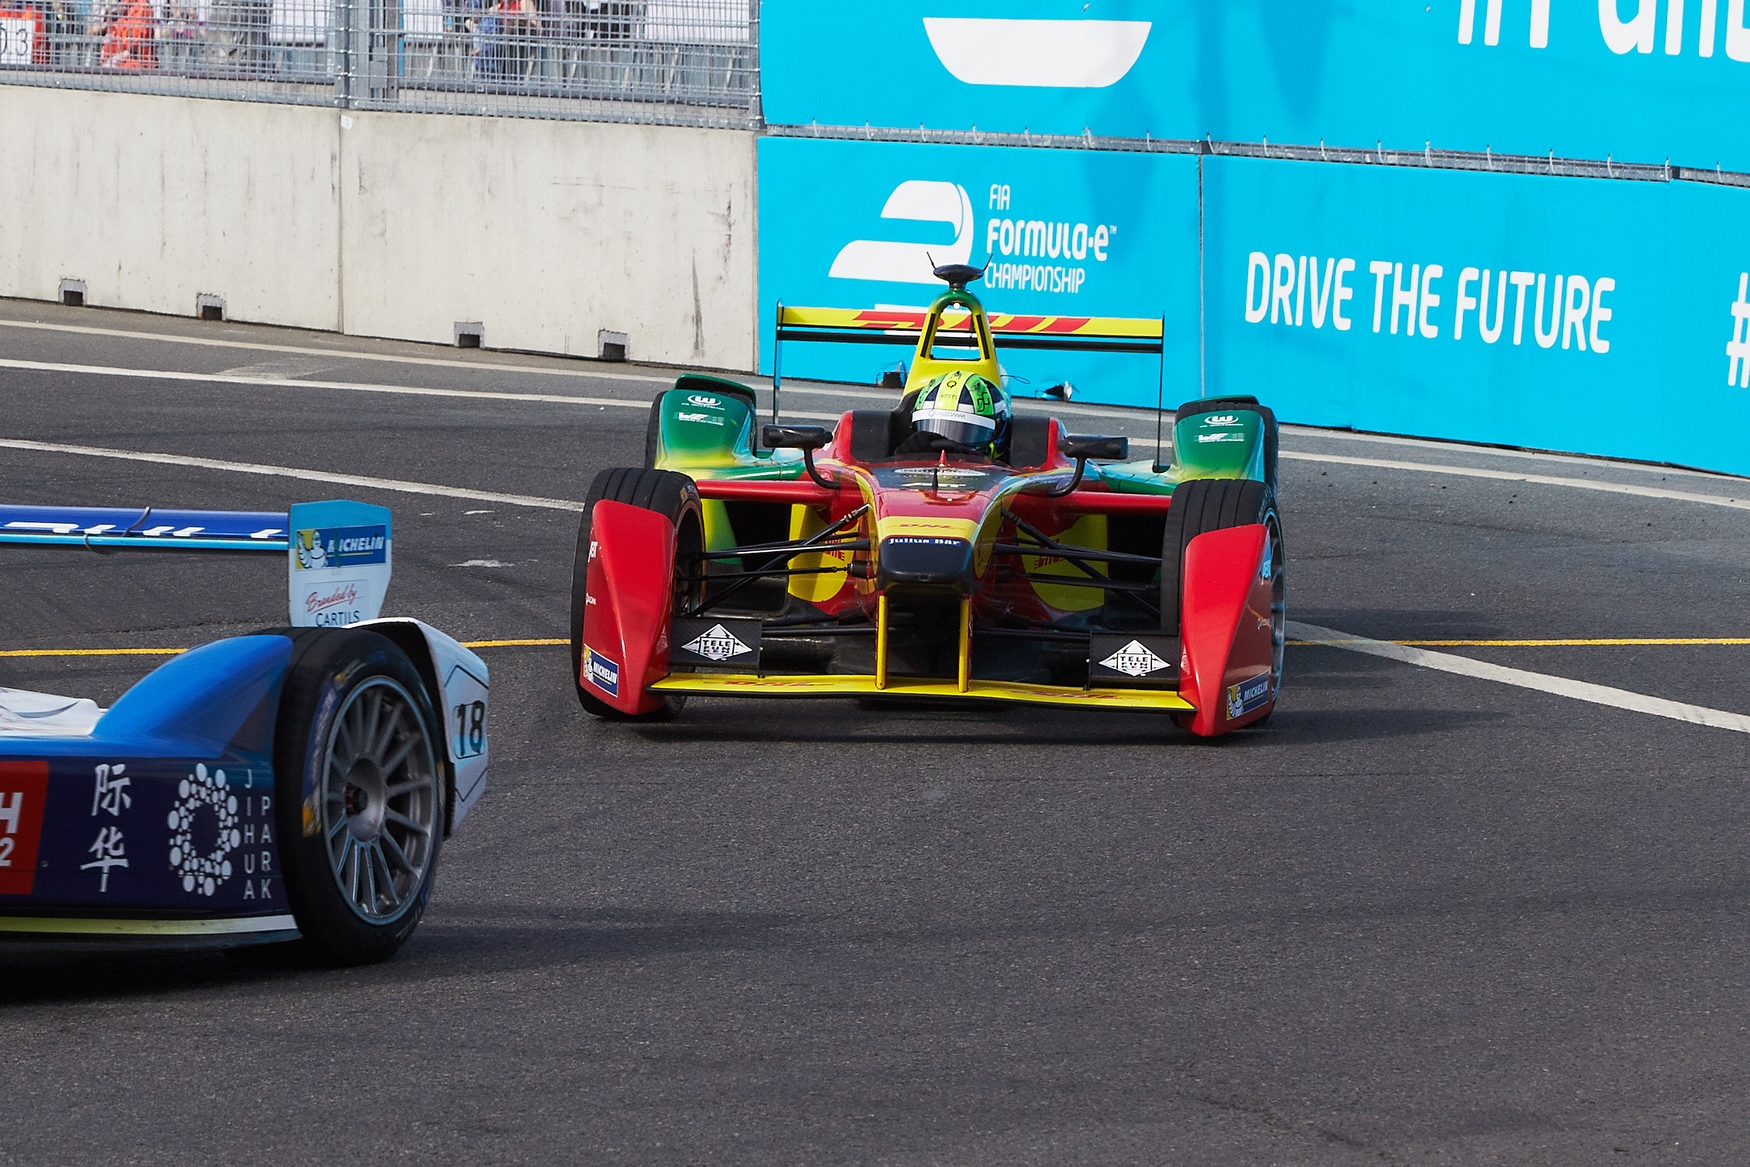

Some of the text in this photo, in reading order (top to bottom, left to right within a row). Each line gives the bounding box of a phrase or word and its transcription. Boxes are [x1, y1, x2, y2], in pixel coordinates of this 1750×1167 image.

[988, 183, 1011, 211] FIA
[983, 262, 1086, 295] CHAMPIONSHIP
[1244, 250, 1617, 355] DRIVE THE FUTURE
[592, 660, 618, 685] MICHELIN
[1243, 680, 1270, 702] MICHELIN
[457, 699, 486, 757] 18
